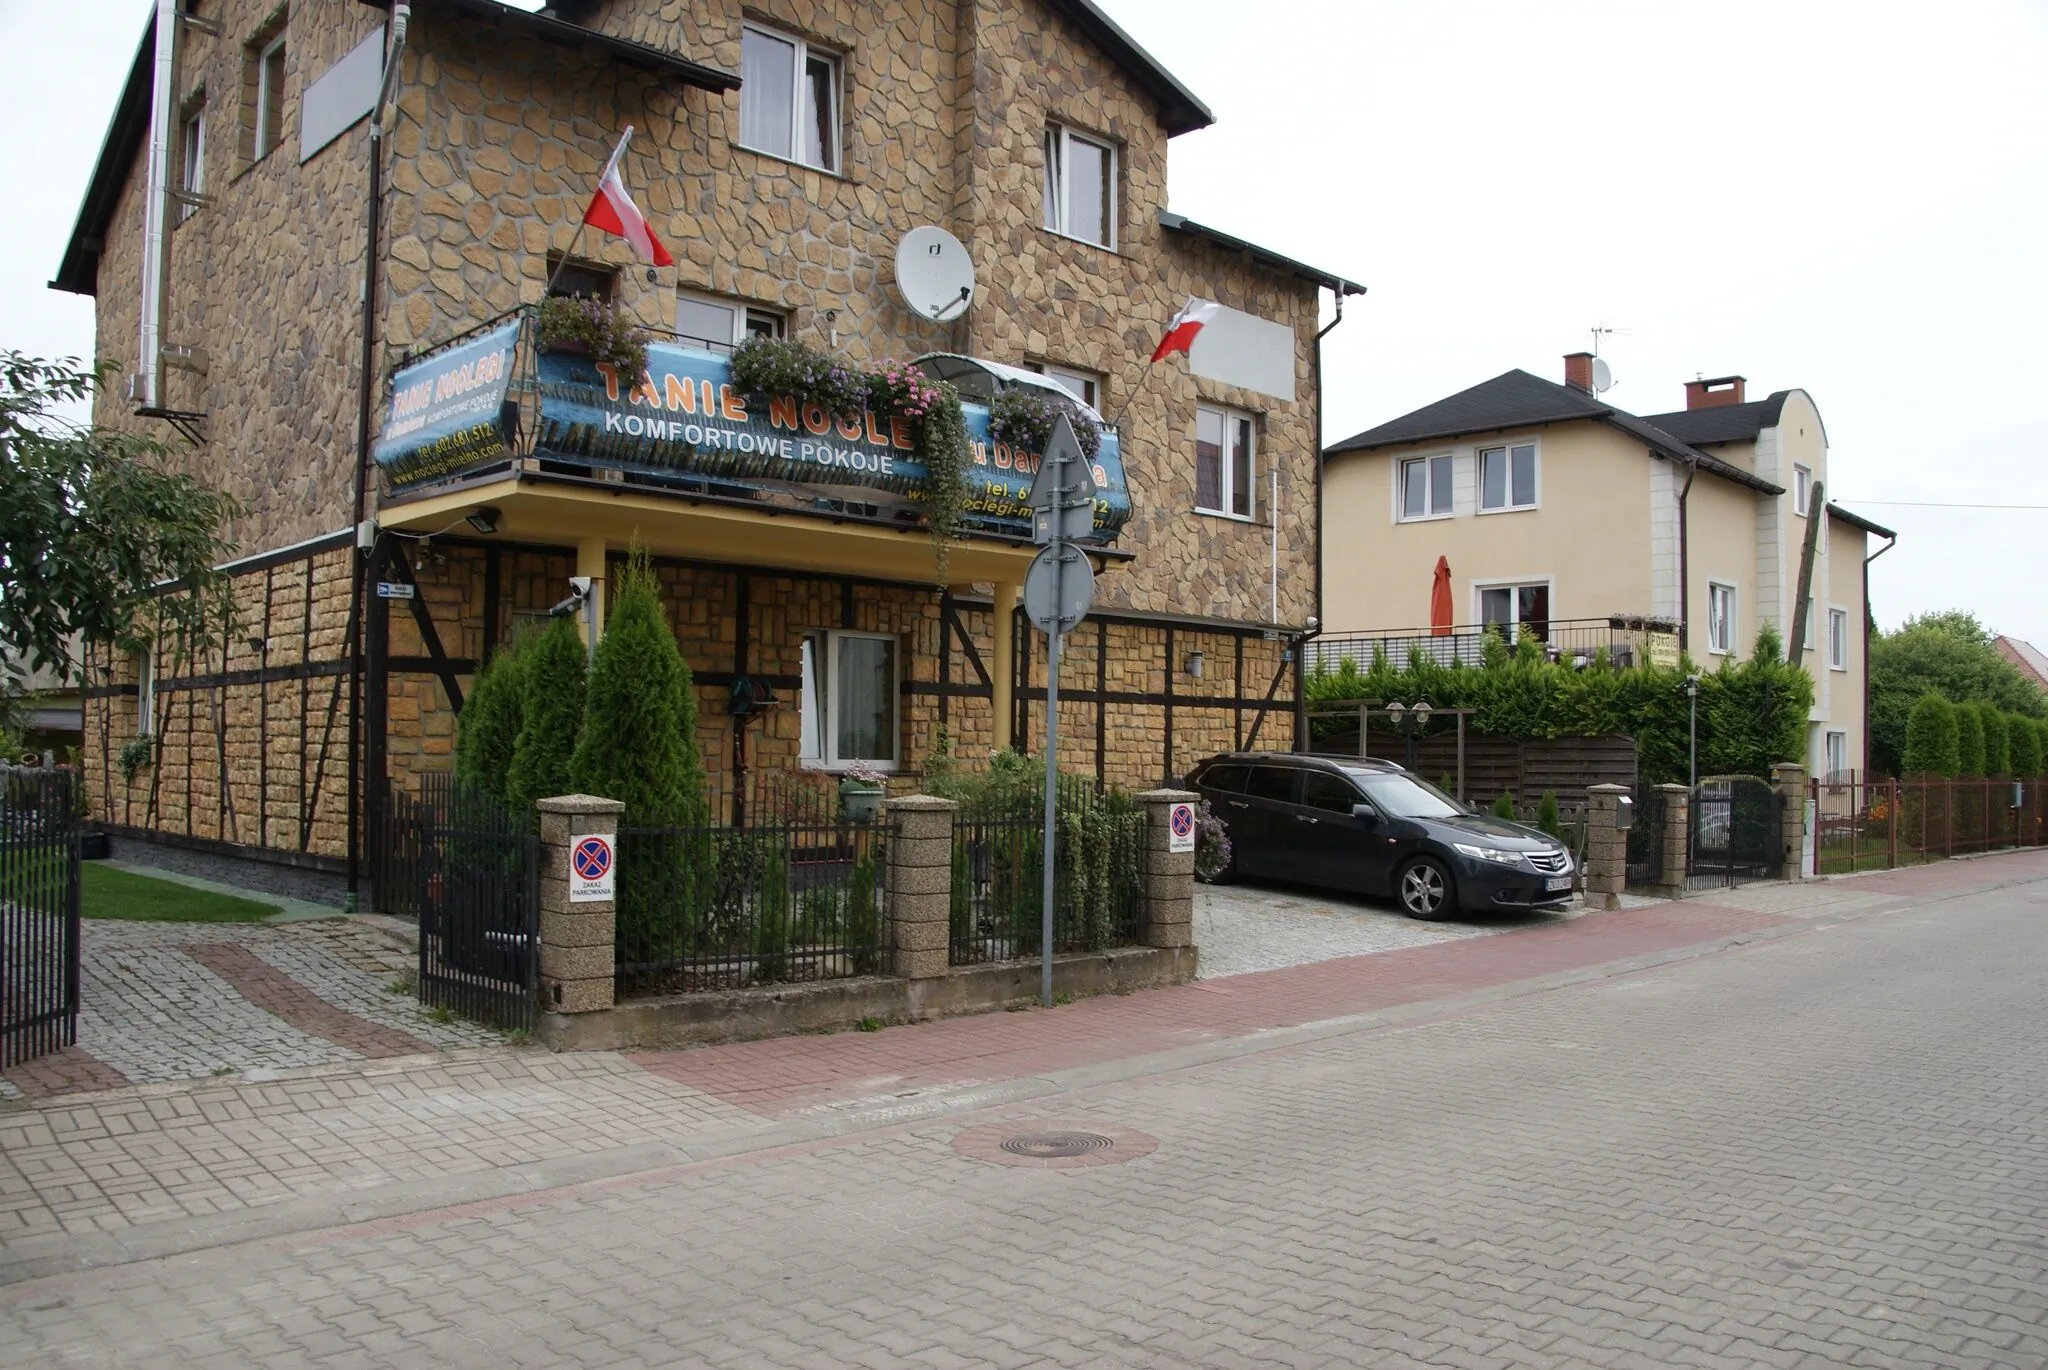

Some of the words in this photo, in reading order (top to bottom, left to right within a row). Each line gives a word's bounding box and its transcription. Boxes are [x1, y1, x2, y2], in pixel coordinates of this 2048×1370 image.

[434, 349, 506, 404] NOCLEGI
[596, 362, 748, 422] TANIE
[392, 442, 504, 485] www.noclegi-mielno.com
[604, 411, 794, 460] KOMFORTOWE
[801, 441, 894, 475] POKOJE
[985, 479, 1012, 498] tel.
[573, 889, 612, 897] PARKOWANIA
